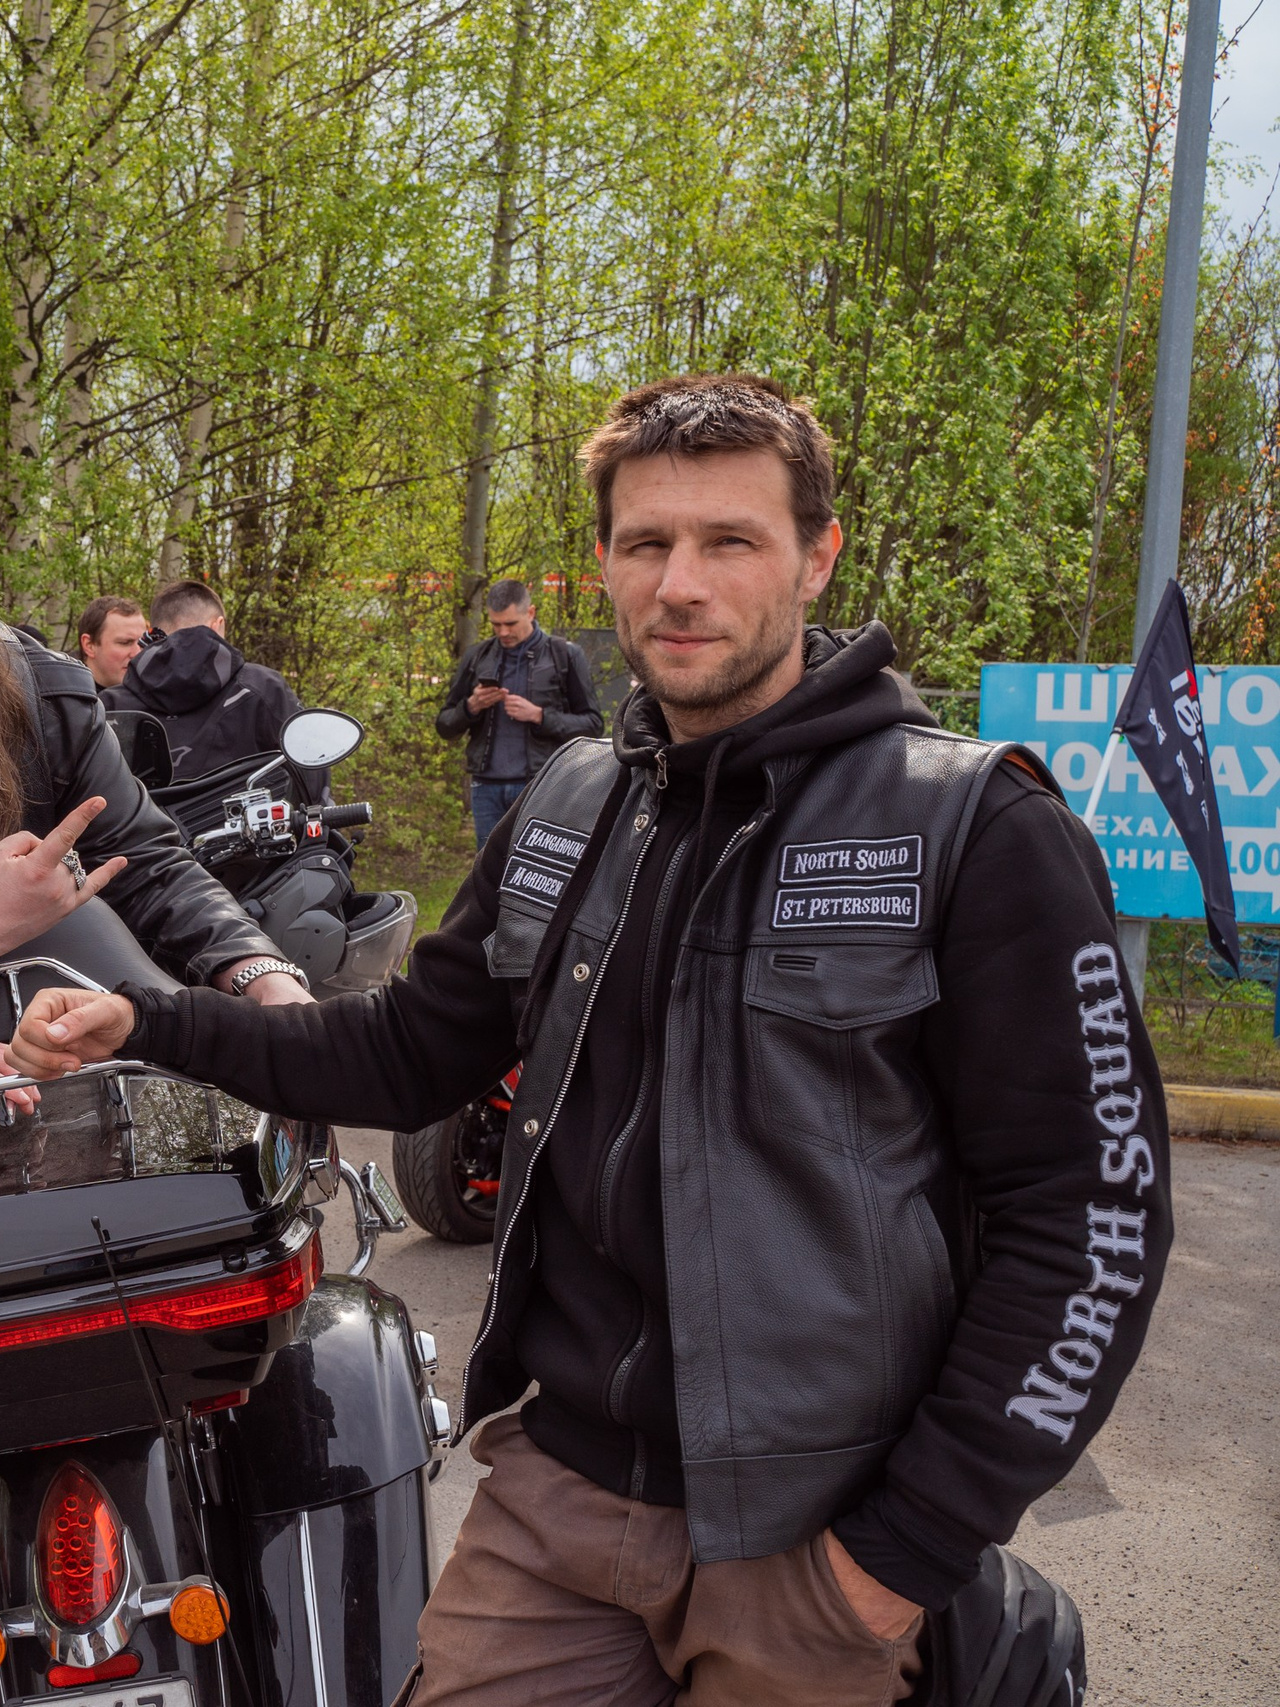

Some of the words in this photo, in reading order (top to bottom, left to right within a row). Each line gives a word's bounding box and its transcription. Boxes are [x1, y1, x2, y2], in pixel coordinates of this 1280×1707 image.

[1078, 814, 1182, 838] ЕХАЛ
[793, 850, 851, 874] NORTH
[854, 847, 909, 871] SQUAD
[808, 896, 912, 919] PETERSBURG
[1071, 940, 1156, 1197] SQUAD
[1005, 1201, 1147, 1446] NORTH
